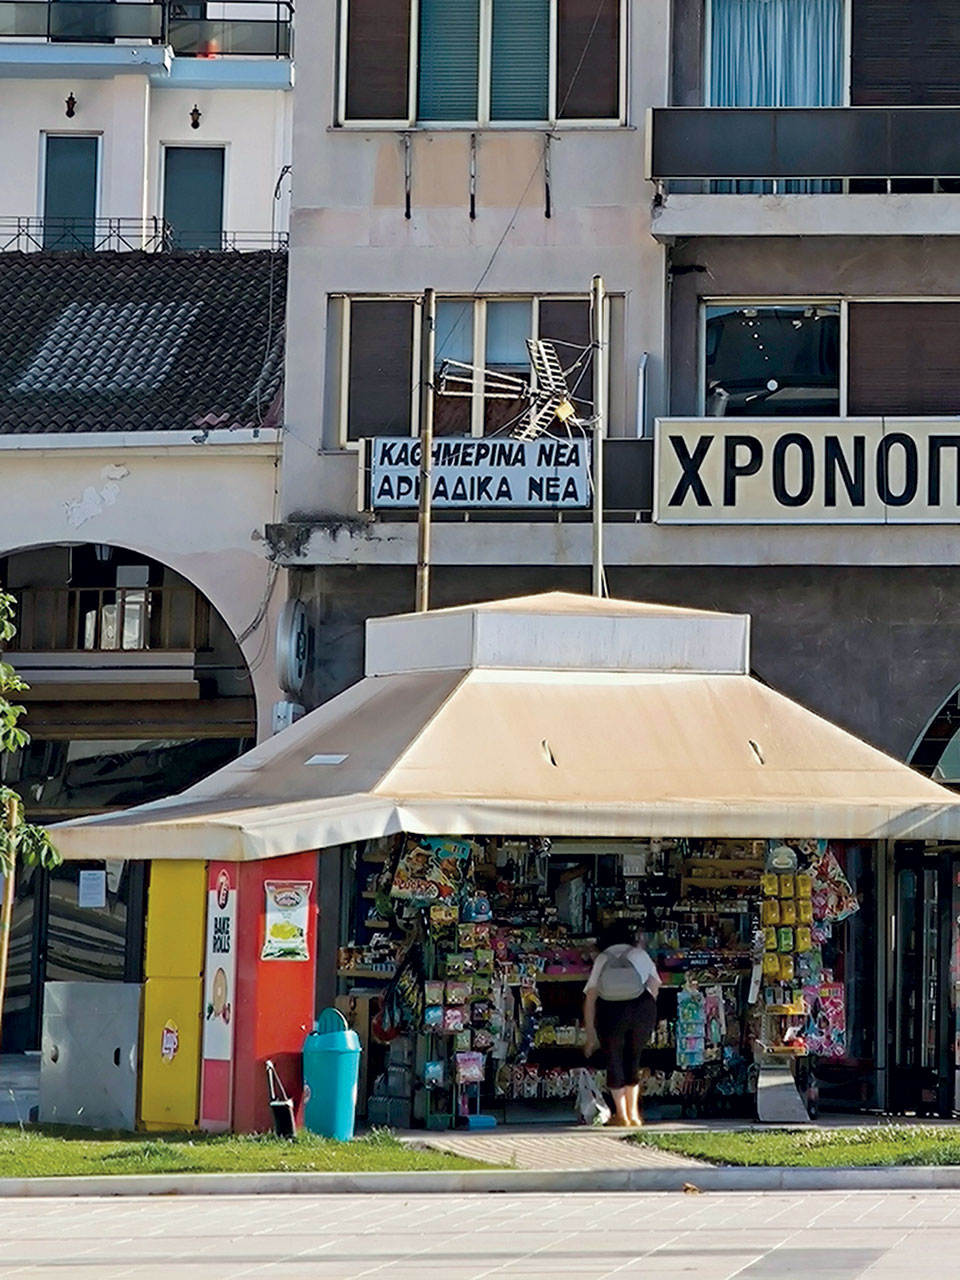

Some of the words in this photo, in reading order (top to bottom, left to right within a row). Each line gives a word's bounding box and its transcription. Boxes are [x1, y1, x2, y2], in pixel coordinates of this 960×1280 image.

[537, 443, 580, 468] ΝΕΑ
[528, 475, 579, 502] ΝΕΑ
[213, 917, 231, 935] BAKE
[212, 935, 231, 953] ROLLS
